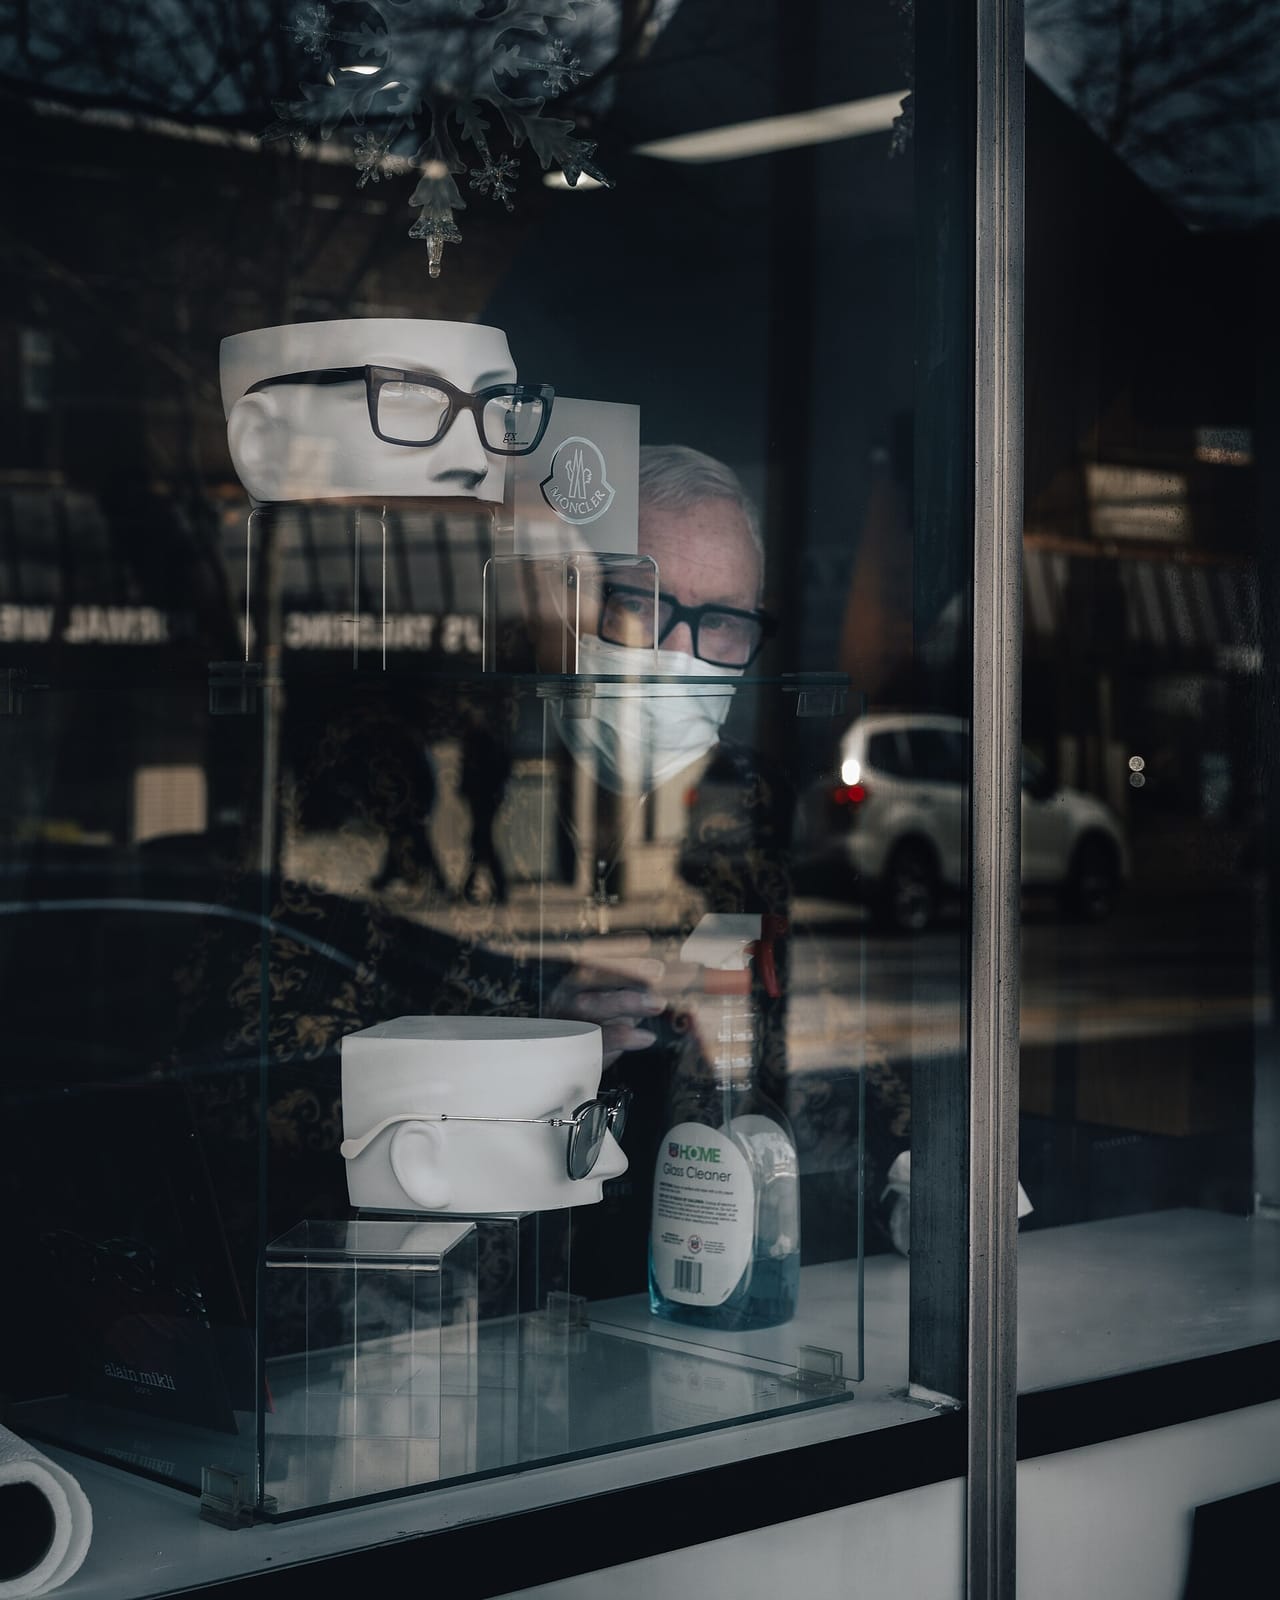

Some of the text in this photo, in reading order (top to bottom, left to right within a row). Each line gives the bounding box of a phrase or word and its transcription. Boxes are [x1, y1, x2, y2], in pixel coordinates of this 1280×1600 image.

[551, 487, 606, 514] MONCLER
[679, 1145, 721, 1163] HOME
[663, 1163, 732, 1182] Glass Cleaner
[104, 1362, 138, 1382] alain
[139, 1370, 176, 1391] mikli
